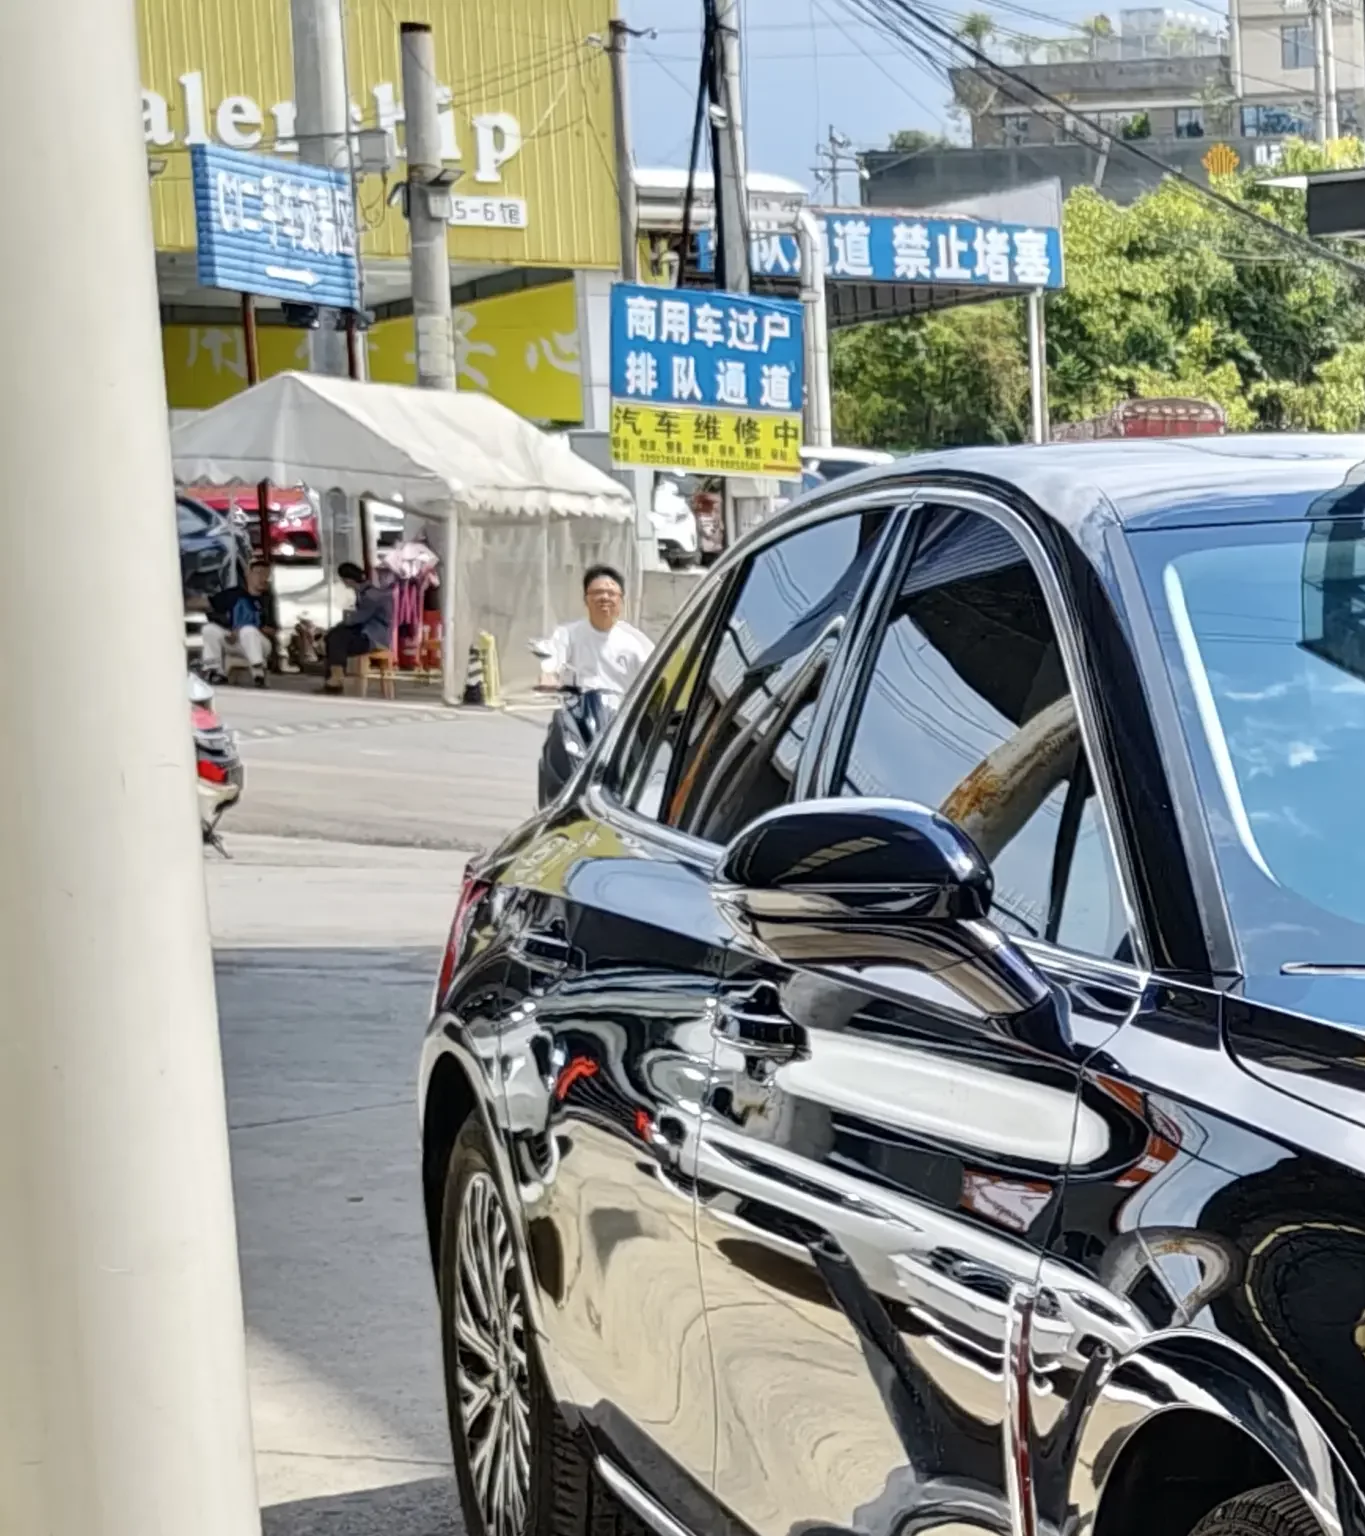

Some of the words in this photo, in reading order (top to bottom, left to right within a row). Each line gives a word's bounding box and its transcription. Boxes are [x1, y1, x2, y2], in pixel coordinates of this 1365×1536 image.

[893, 223, 1051, 285] 禁止堵塞
[625, 296, 791, 353] 商用车过户
[625, 350, 792, 409] 排队通道
[614, 406, 799, 448] 汽车维修中
